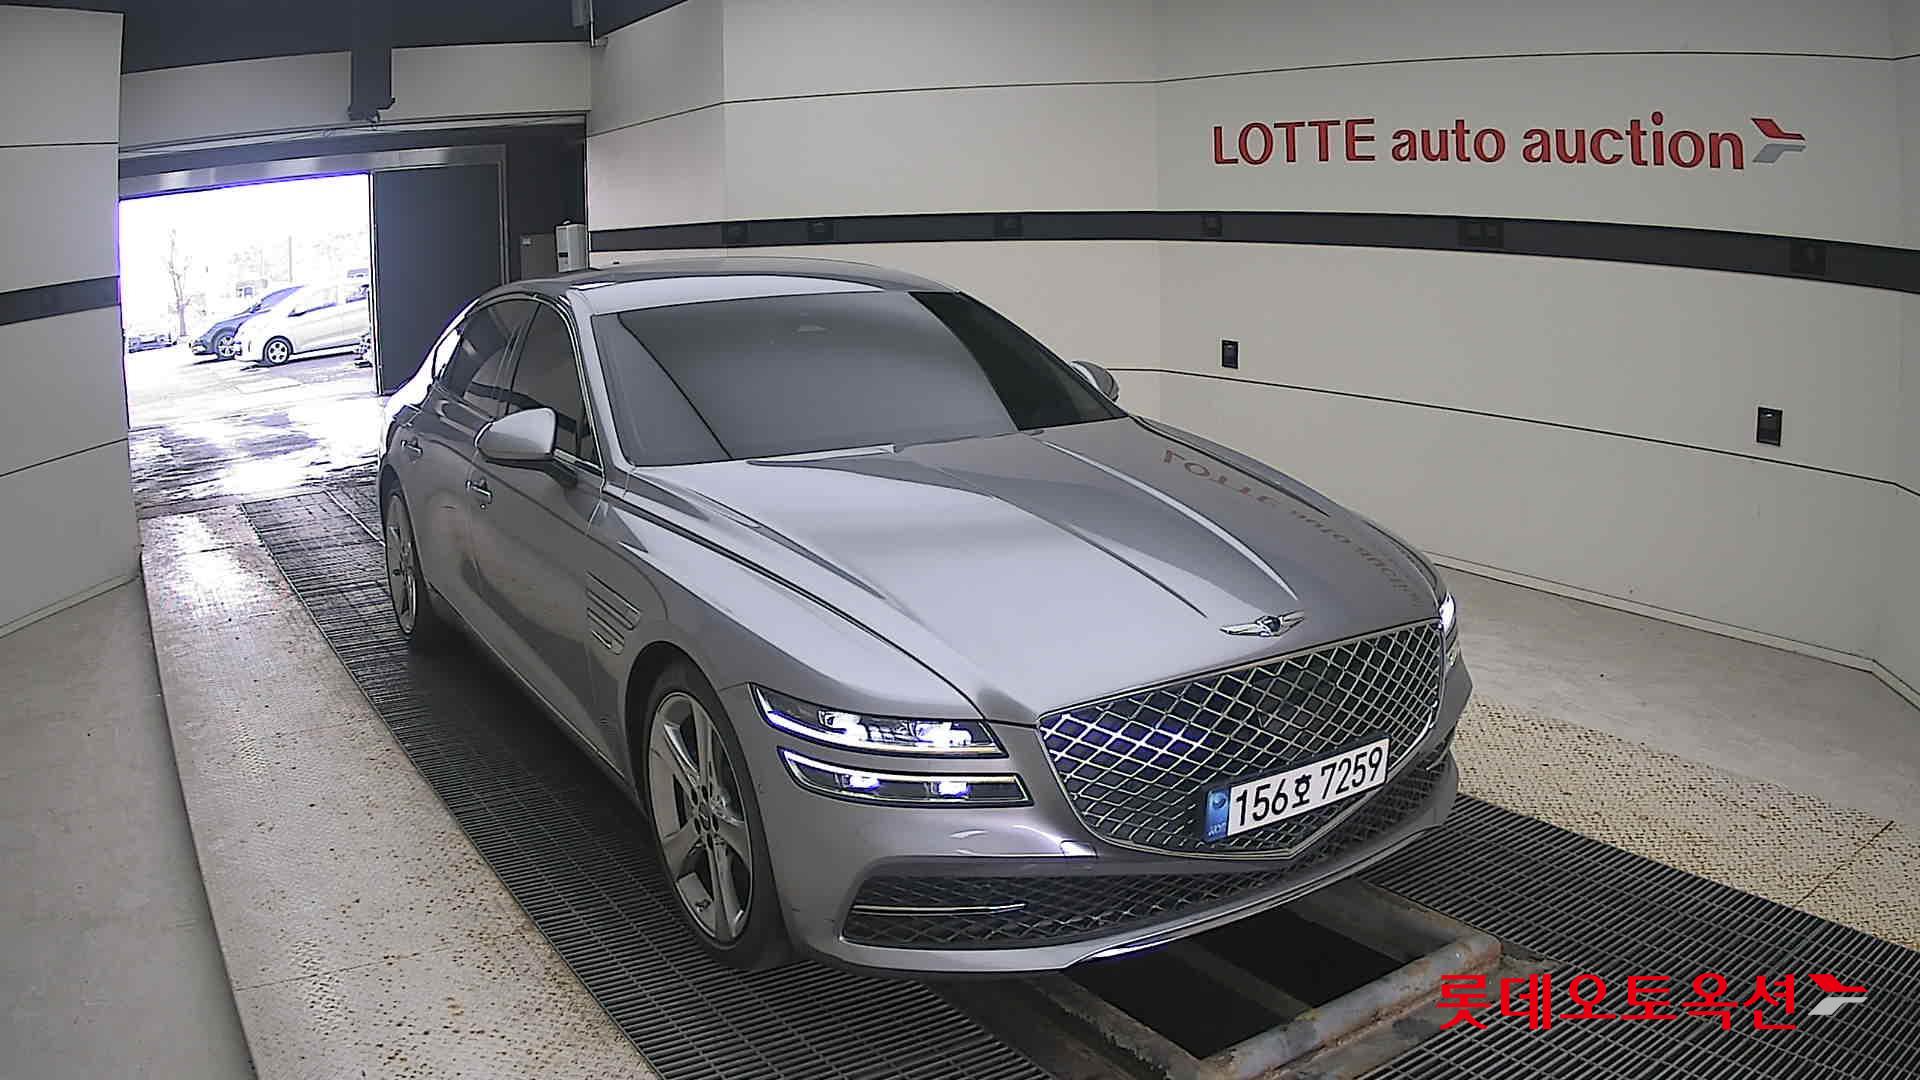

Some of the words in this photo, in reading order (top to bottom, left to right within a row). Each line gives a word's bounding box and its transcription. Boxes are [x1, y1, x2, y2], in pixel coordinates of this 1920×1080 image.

[1213, 118, 1376, 165] LOTTE
[1391, 118, 1505, 163] auto
[1521, 111, 1745, 170] auction
[1236, 774, 1312, 827] 156호
[1320, 746, 1383, 800] 7259
